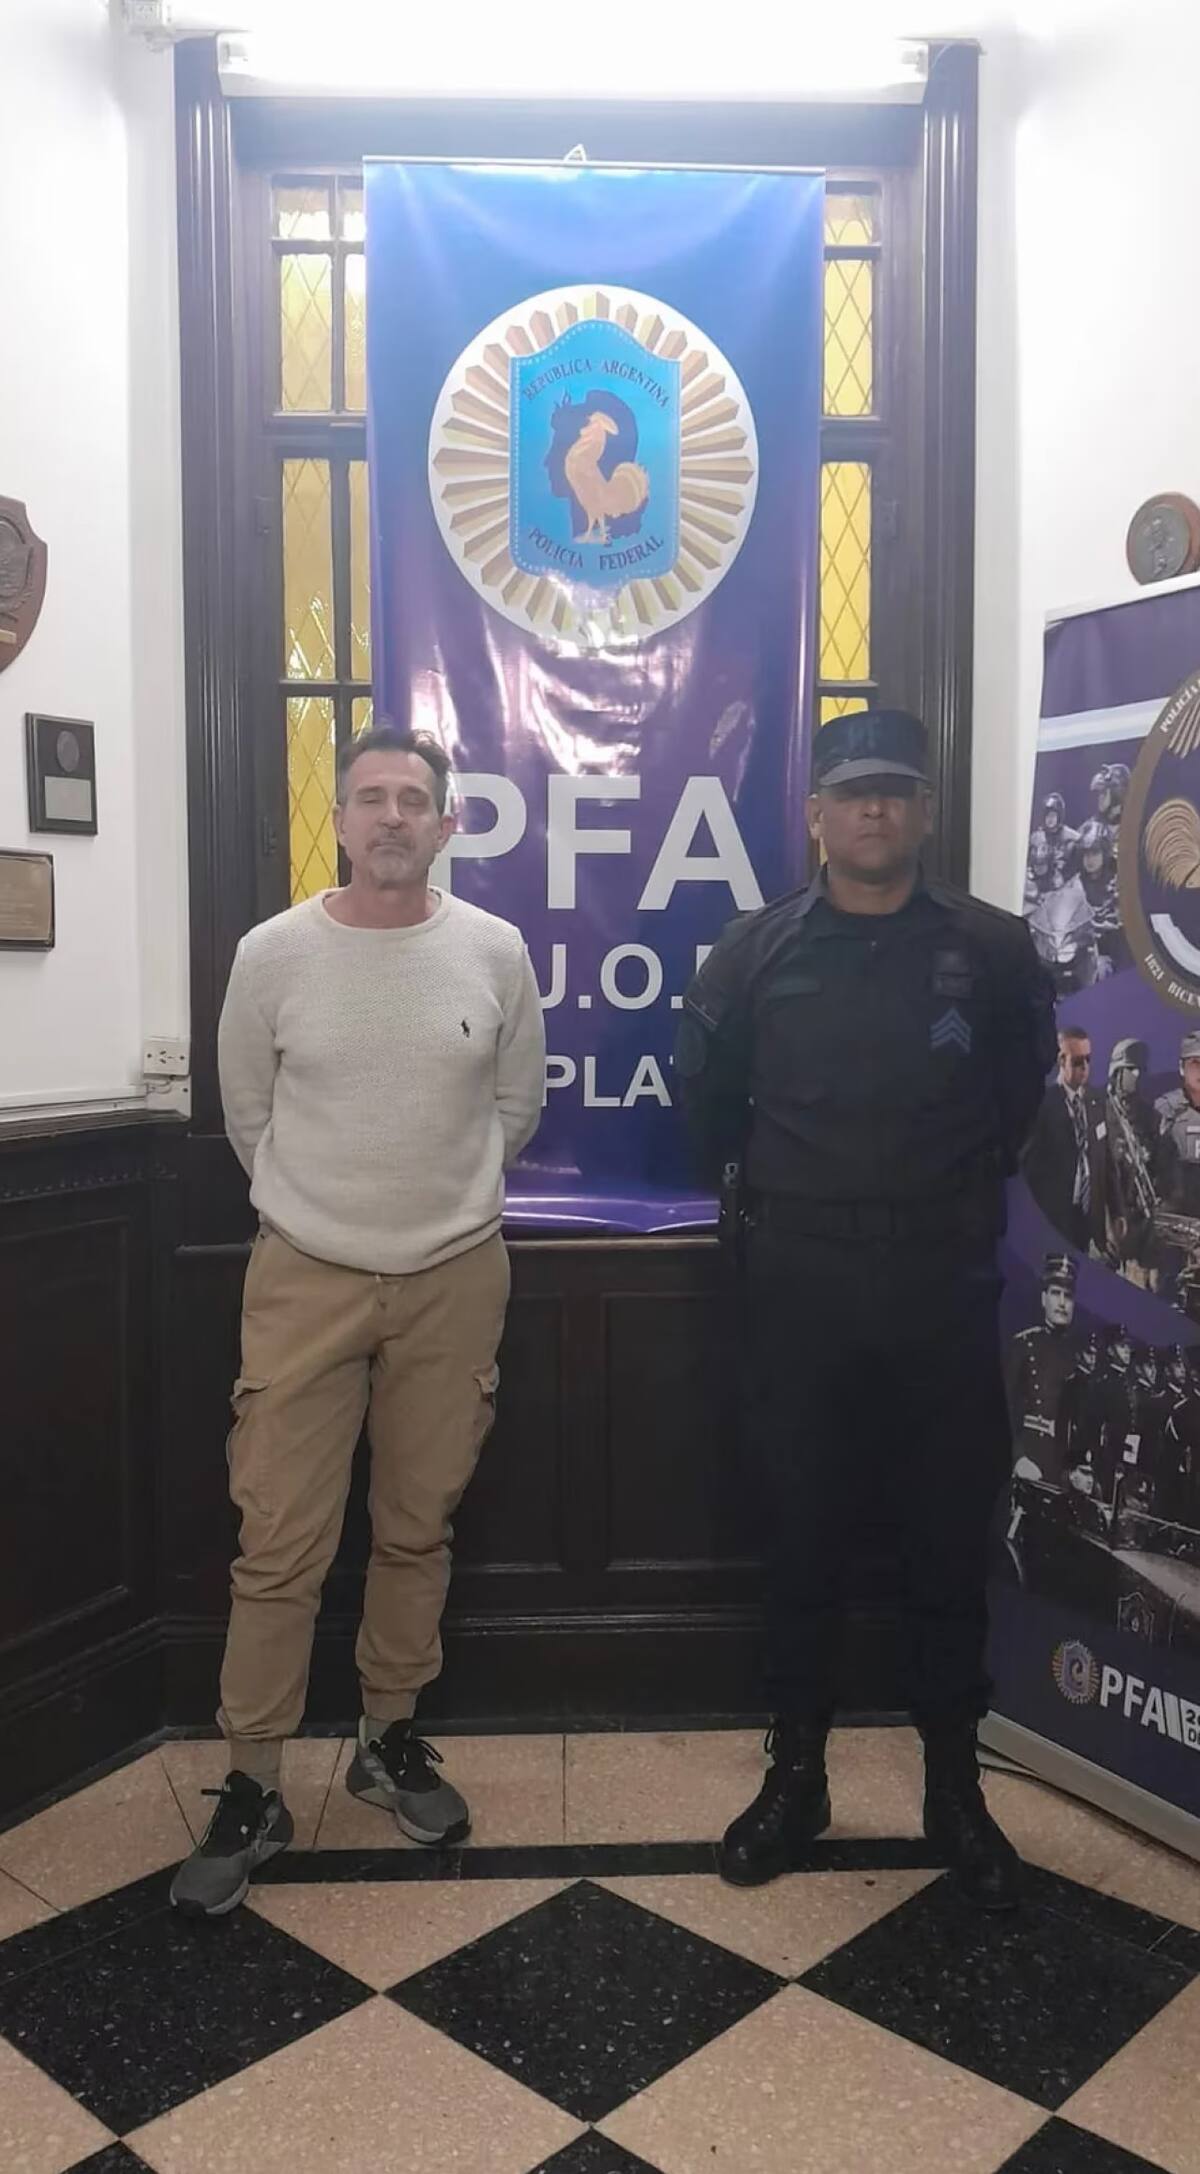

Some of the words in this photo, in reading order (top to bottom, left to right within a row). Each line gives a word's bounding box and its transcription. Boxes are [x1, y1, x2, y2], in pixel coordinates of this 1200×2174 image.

[601, 360, 670, 408] ARGENTINA
[600, 535, 665, 570] FEDERAL
[428, 773, 765, 911] PFA
[525, 943, 713, 1010] U.O.
[1168, 982, 1200, 1007] BICE
[542, 1055, 673, 1107] PLA
[1100, 1664, 1166, 1735] PFA
